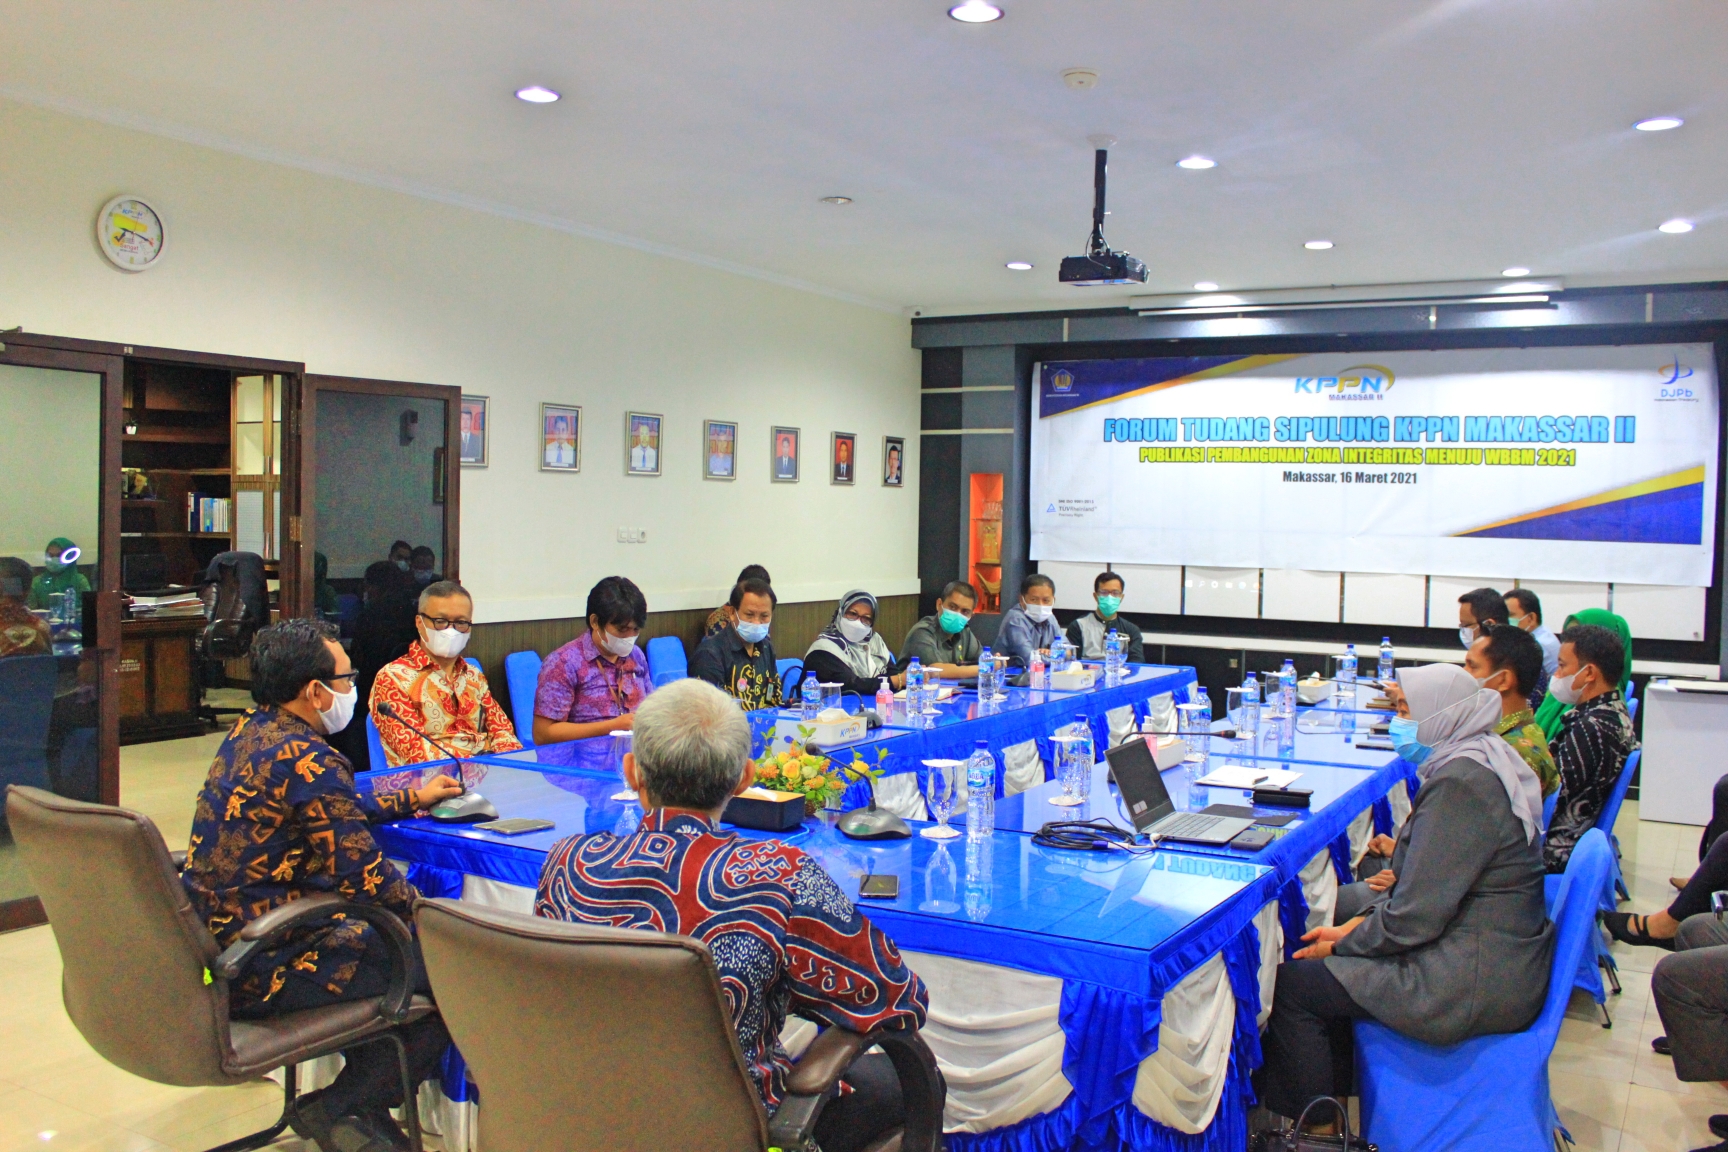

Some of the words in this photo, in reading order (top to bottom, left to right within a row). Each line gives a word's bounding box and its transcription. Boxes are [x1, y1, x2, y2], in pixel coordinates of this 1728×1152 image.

[1294, 376, 1382, 393] KPPN
[1661, 388, 1693, 397] DJPb
[1104, 418, 1177, 442] FORUM
[1181, 417, 1270, 442] TUDANG
[1274, 416, 1389, 442] SIPULUNG
[1394, 416, 1459, 442] KPPN
[1464, 416, 1609, 443] MAKASSAR
[1614, 416, 1635, 443] II
[1139, 447, 1205, 463] PUBLIKASI
[1207, 447, 1305, 463] PEMBANGUNAN
[1306, 447, 1342, 464] ZONA
[1343, 448, 1423, 464] INTEGRITAS
[1425, 448, 1483, 465] MENUJU
[1484, 448, 1535, 466] WBBM
[1537, 449, 1576, 466] 2021
[1283, 471, 1338, 484] Makassar,
[1340, 472, 1352, 483] 16
[1355, 472, 1388, 484] Maret
[1390, 472, 1417, 484] 2021
